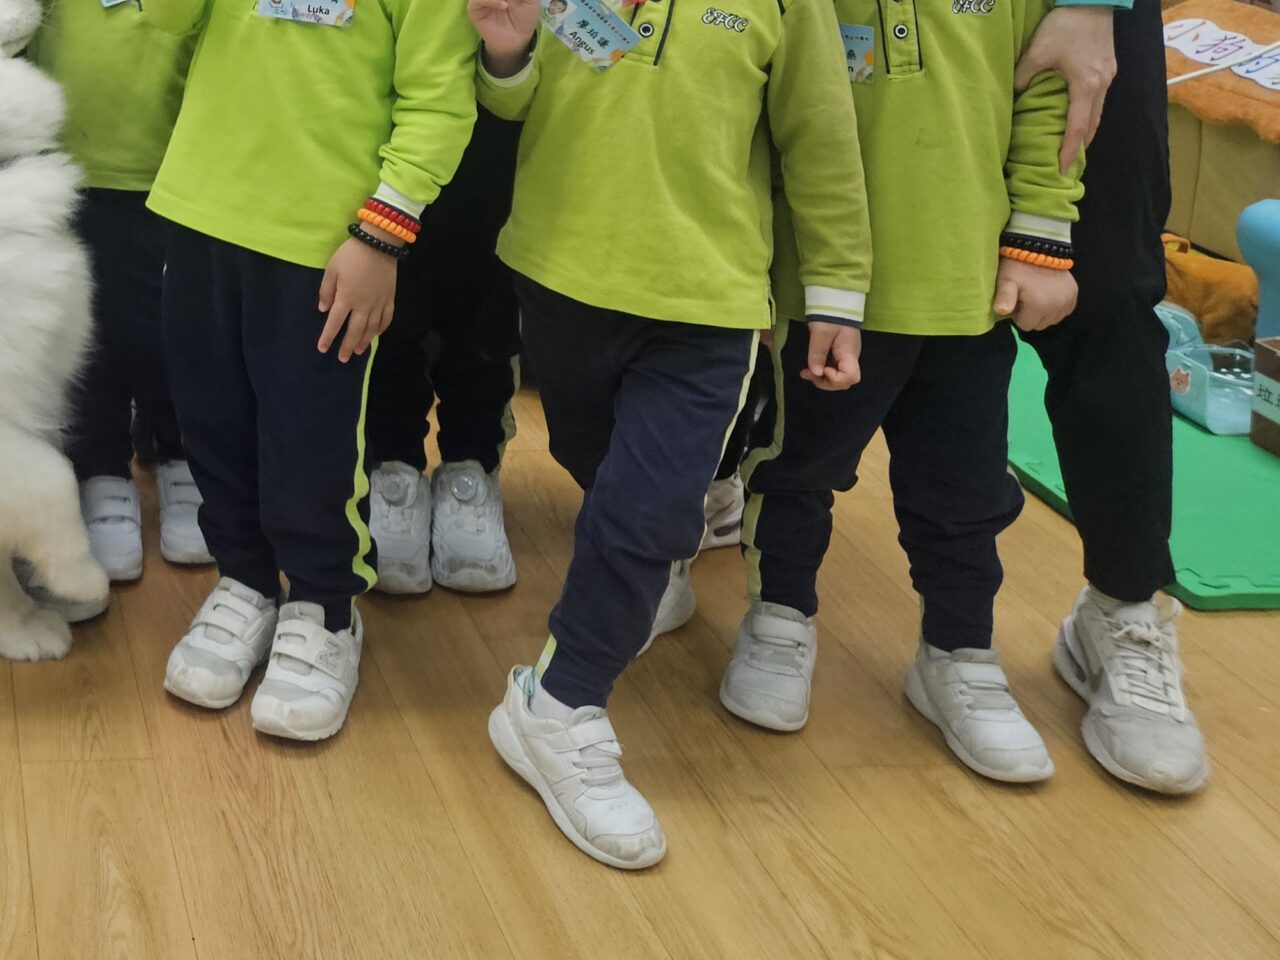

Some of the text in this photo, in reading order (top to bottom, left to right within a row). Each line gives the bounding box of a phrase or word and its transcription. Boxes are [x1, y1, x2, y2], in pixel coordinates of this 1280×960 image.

[307, 4, 330, 16] Luka
[701, 6, 749, 33] EFCC
[569, 31, 596, 56] Angus
[1256, 383, 1280, 408] 垃
